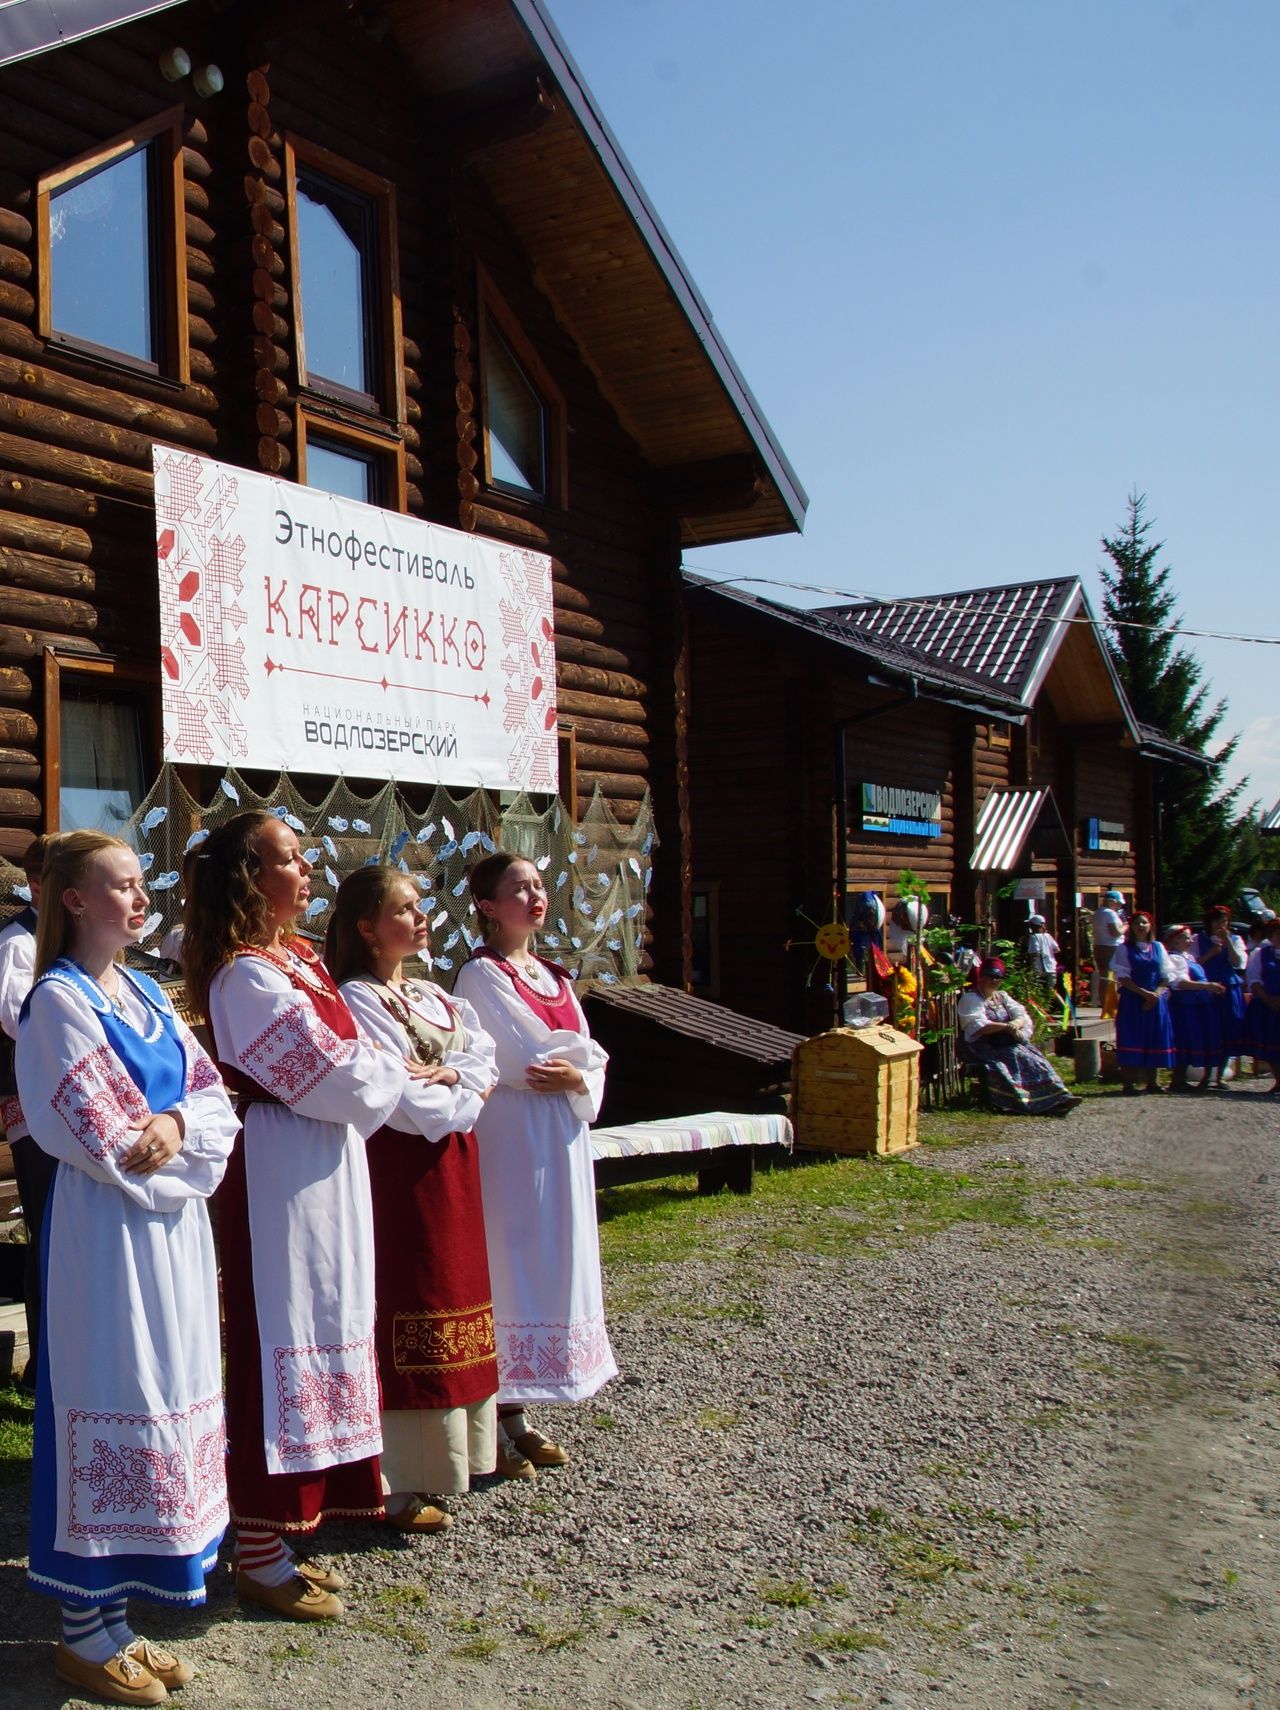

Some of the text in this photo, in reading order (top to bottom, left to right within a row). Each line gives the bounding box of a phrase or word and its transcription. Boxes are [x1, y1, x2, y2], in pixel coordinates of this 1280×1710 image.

[274, 509, 476, 590] Этнофестиваль
[263, 575, 487, 672] КАРСИККО
[302, 703, 457, 734] НАЦИОНАЛЬНЫЙ ПАРК
[304, 720, 458, 759] ВОДЛОЗЕРСКИЙ
